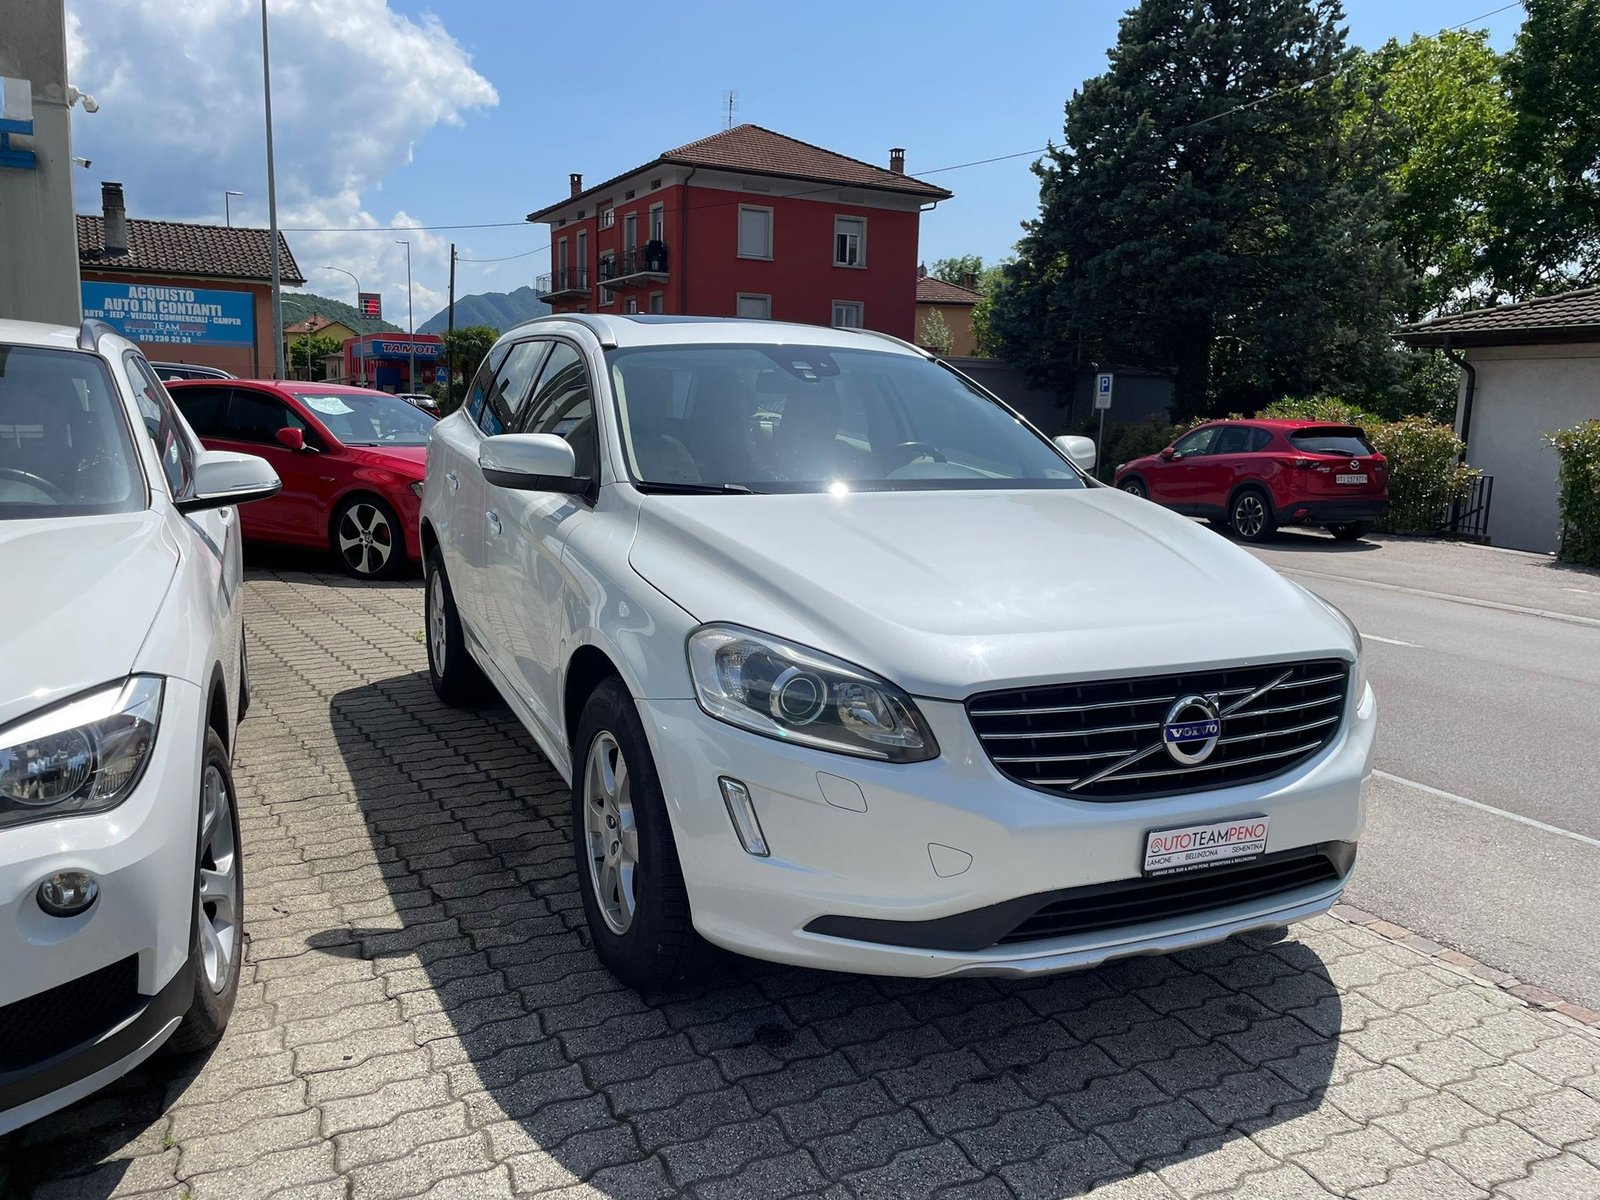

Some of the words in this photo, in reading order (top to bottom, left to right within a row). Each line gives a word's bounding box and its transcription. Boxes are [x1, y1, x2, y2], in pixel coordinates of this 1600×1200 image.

[128, 286, 194, 302] ACQUISTO
[104, 298, 139, 311] AUTO
[142, 300, 156, 312] IN
[159, 302, 222, 316] CONTANTI
[84, 309, 104, 318] AUTO
[131, 312, 158, 321] VEICOLI
[159, 314, 208, 323] COMMERCIALI
[213, 317, 241, 326] CAMPER
[383, 343, 438, 355] TAMOIL
[1102, 378, 1108, 391] P
[1170, 724, 1217, 738] VOLVO
[1147, 856, 1172, 867] LAMONE
[1185, 850, 1218, 860] BELLINZONA
[1232, 843, 1263, 854] SEMENTINA
